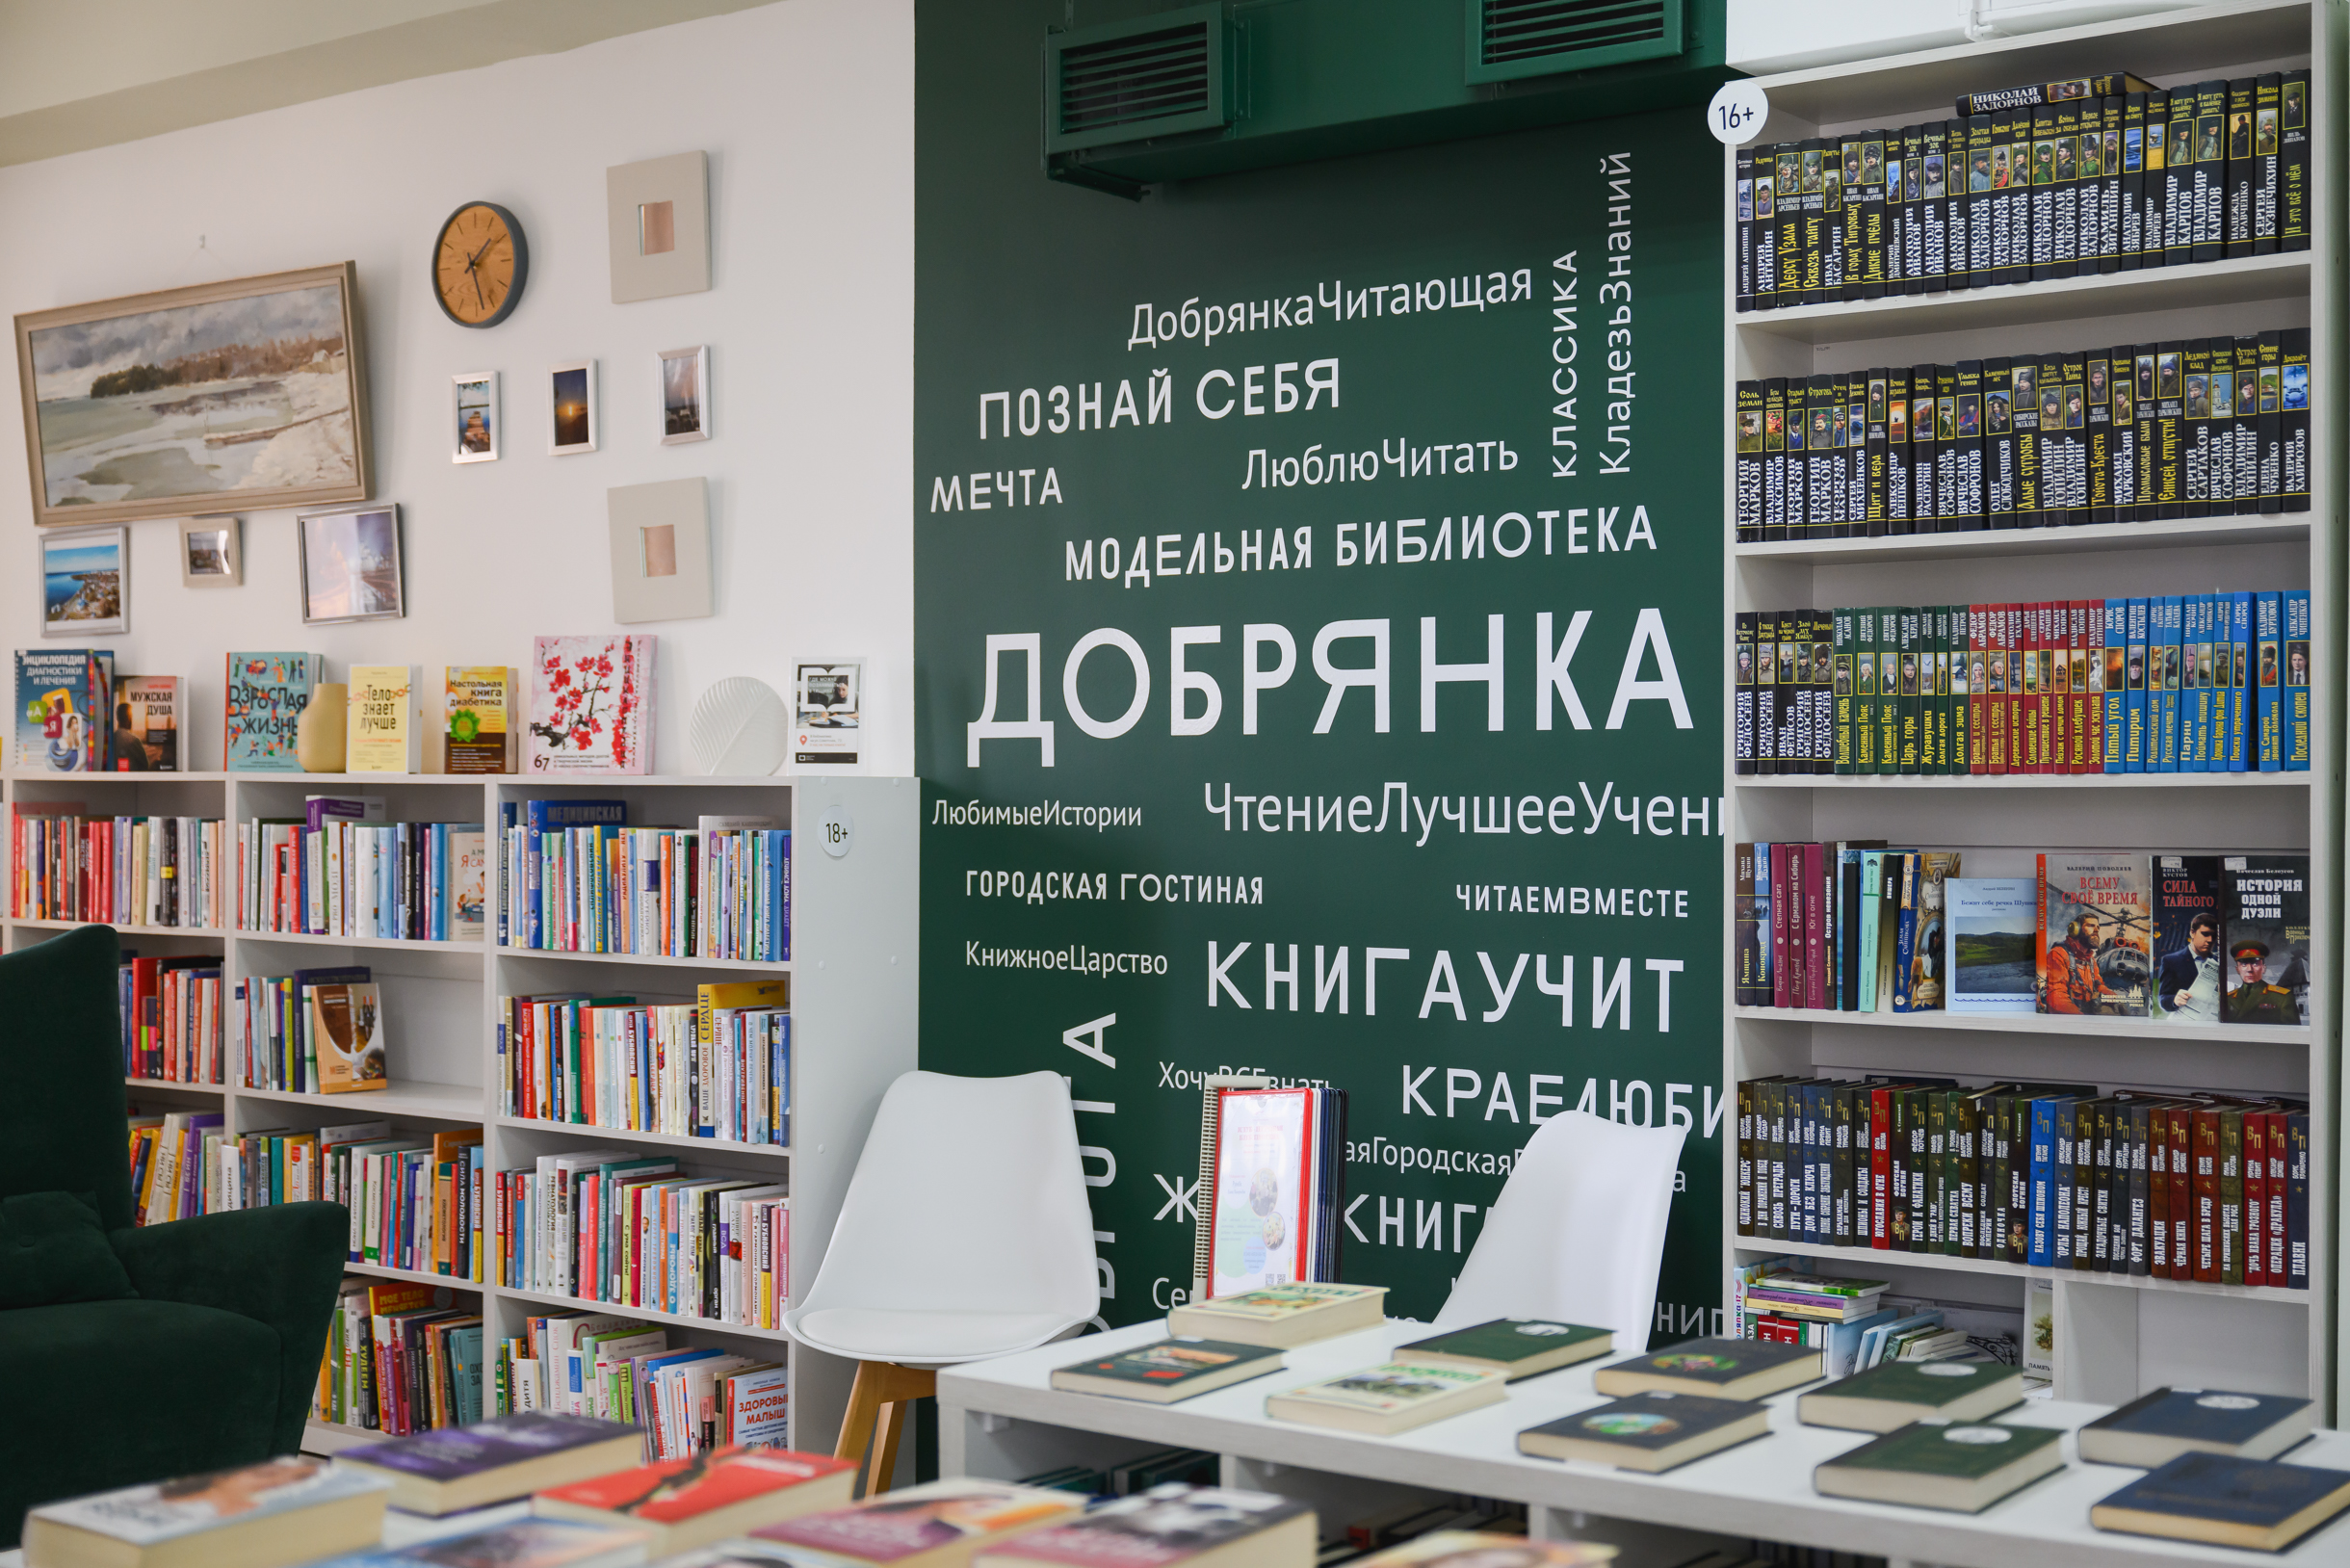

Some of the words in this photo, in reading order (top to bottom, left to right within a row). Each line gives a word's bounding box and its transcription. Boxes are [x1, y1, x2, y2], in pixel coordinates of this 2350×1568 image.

[1972, 86, 2039, 104] НИКОЛАЙ
[1972, 94, 2042, 113] ЗАДОРНОВ
[1718, 103, 1754, 130] 16+
[2194, 170, 2207, 242] ВЛАДИМИР
[2256, 189, 2265, 236] СЕРГЕЙ
[2266, 156, 2277, 235] КУЗНЕЧИХИН
[2208, 187, 2222, 240] КАРПОВ
[1924, 204, 1934, 274] АНАТОЛИЙ
[1935, 221, 1944, 274] ИВАНОВ
[1971, 202, 1980, 269] НИКОЛАЙ
[1980, 198, 1991, 269] ЗАДОРНОВ
[1764, 230, 1774, 291] АНТИПИН
[1833, 226, 1841, 285] БАСАРГИН
[1128, 267, 1533, 350] ДобрянкаЧитающая
[1599, 150, 1636, 474] КладезьЗнаний
[1553, 250, 1579, 478] КЛАССИКА
[979, 369, 1172, 440] ПОЗНАЙ
[1195, 357, 1339, 420] СЕБЯ
[1241, 437, 1519, 489] ЛюблюЧитать
[2260, 458, 2269, 493] ЕЛЕНА
[2270, 442, 2280, 493] ЧУБЕНКО
[2285, 441, 2295, 491] ВАЛЕРИЙ
[2295, 429, 2305, 491] ХАЙРЮЗОВ
[930, 467, 1063, 512] МЕЧТА
[1738, 459, 1749, 525] ГЕОРГИЙ
[1750, 462, 1761, 525] МАРКОВ
[1765, 459, 1774, 524] ВЛАДИМИР
[1775, 456, 1784, 524] МАКСИМОВ
[1857, 450, 1866, 520] МИХЕЕНКОВ
[1064, 526, 1313, 588] МОДЕЛЬНАЯ
[1336, 505, 1658, 567] БИБЛИОТЕКА
[1977, 612, 1986, 647] АБРАМОВ
[23, 655, 86, 666] ЭНЦИКЛОПЕДИЯ
[27, 666, 82, 676] ДИАГНОСТИКИ
[40, 676, 76, 685] ЛЕЧЕНИЯ
[130, 692, 171, 702] МУЖСКАЯ
[367, 685, 390, 700] Тело
[471, 689, 502, 697] книга
[967, 607, 1695, 768] ДОБРЯНКА
[146, 705, 171, 715] ДУША
[363, 702, 395, 716] знает
[450, 698, 502, 707] диабетика
[1858, 705, 1868, 722] Пояс
[2073, 699, 2086, 733] хлебушек
[2108, 697, 2124, 720] угол
[360, 717, 396, 733] лучше
[1744, 692, 1753, 757] ФЕДОСЕЕВ
[1902, 717, 1915, 739] горы
[1921, 711, 1934, 765] Журавушки
[2180, 720, 2192, 761] Парни
[2291, 722, 2309, 761] Последний
[1859, 725, 1868, 763] Каменный
[1901, 743, 1917, 765] Царь
[1954, 732, 1965, 764] Долгая
[2073, 736, 2083, 764] Росяной
[535, 754, 549, 771] 67
[547, 806, 622, 823] МЕДИЦИНСКАЯ
[932, 799, 1142, 833] ЛюбимыеИстории
[826, 823, 848, 843] 18+
[1790, 855, 1799, 879] Сибирь
[2080, 876, 2119, 889] ВСЕМУ
[965, 871, 1108, 905] ГОРОДСКАЯ
[1120, 873, 1264, 905] ГОСТИНАЯ
[1455, 883, 1689, 918] ЧИТАЕМВМЕСТЕ
[2062, 890, 2094, 904] СВОЁ
[2098, 892, 2138, 904] ВРЕМЯ
[2163, 880, 2197, 893] СИЛА
[2163, 893, 2213, 907] ТАЙНОГО
[2236, 879, 2302, 892] ИСТОРИЯ
[2242, 892, 2281, 904] ОДНОЙ
[1824, 914, 1833, 938] Остров
[2242, 907, 2281, 919] ДУЭЛИ
[965, 940, 1168, 978] КнижноеЦарство
[1207, 940, 1684, 1033] КНИГАУЧИТ
[700, 992, 710, 1040] СЕРДЦЕ
[1773, 1162, 1785, 1197] ПРЕГРАДЫ
[1805, 1164, 1815, 1191] КЛЮЧА
[1912, 1172, 1924, 1208] ФАНАТИКИ
[1739, 1190, 1751, 1224] ОДИНОКИЙ
[1805, 1196, 1815, 1210] БЕЗ
[1962, 1183, 1973, 1208] ВСЕМУ
[1343, 1194, 1491, 1255] КНИГ
[1773, 1202, 1784, 1228] СКВОЗЬ
[1805, 1215, 1816, 1231] ДОМ
[1912, 1221, 1923, 1241] ГЕРОИ
[1962, 1213, 1973, 1246] ВОПРЕКИ
[2132, 1198, 2144, 1238] ДАЛАНГЕЗ
[2131, 1242, 2143, 1262] ФОРТ
[2154, 1220, 2167, 1265] ЭВАКУАЦИЯ
[2292, 1241, 2306, 1275] ПЛАВНИ
[746, 1409, 785, 1424] МАЛЫШ
